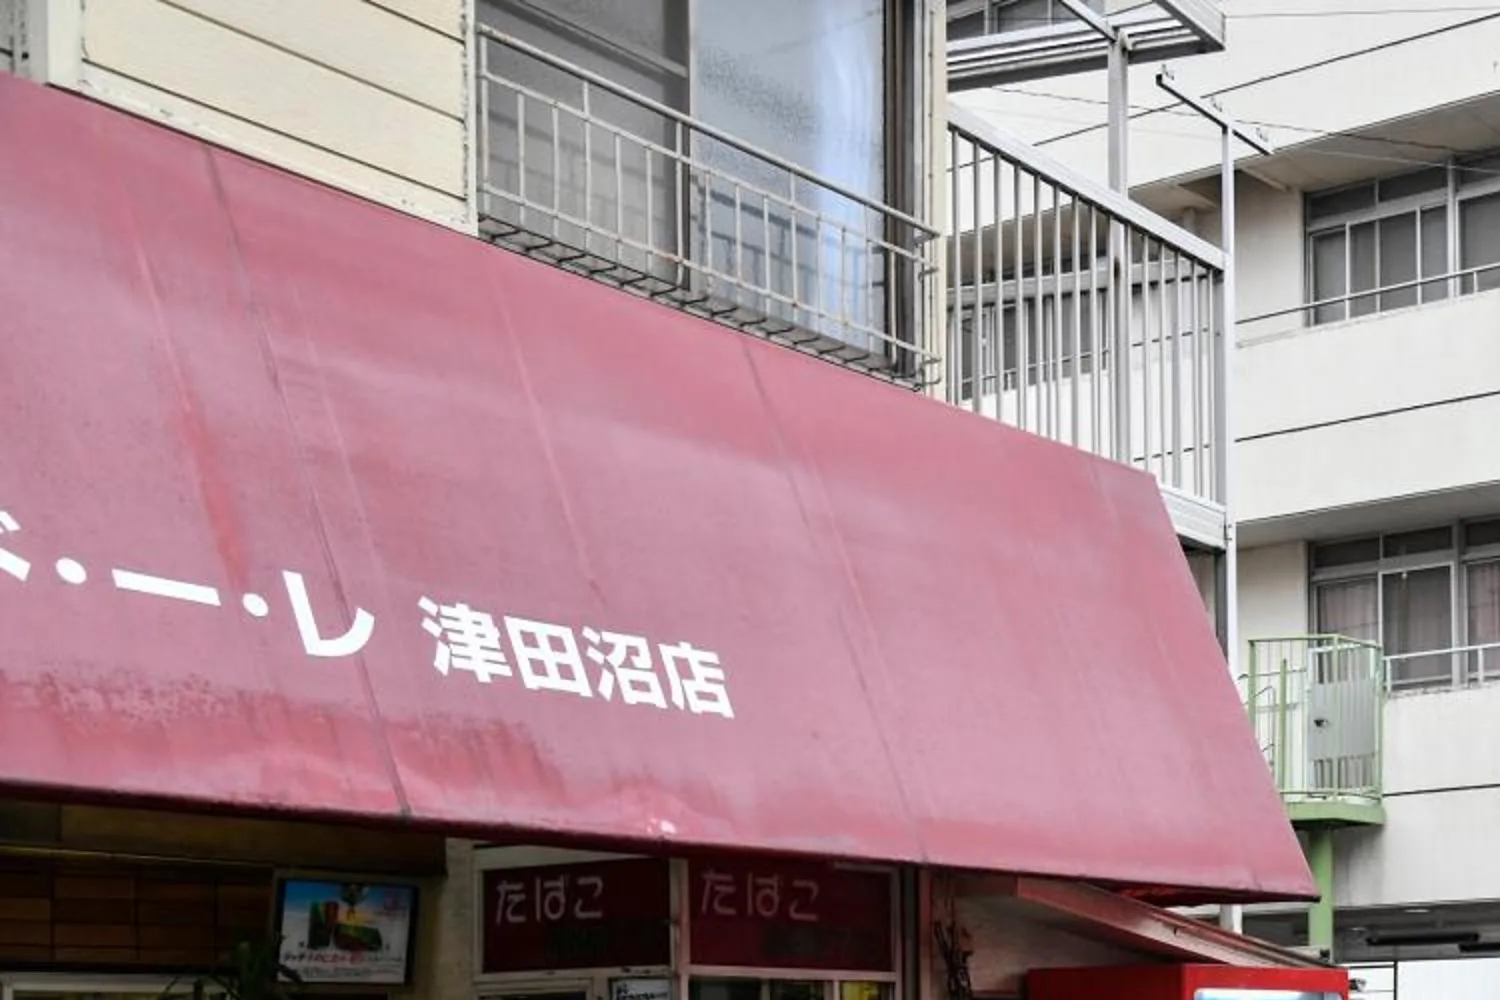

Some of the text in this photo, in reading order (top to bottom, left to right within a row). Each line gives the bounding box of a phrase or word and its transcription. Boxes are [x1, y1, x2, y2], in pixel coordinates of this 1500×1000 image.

[417, 595, 734, 718] 津田沼店
[496, 874, 604, 924] たばこ
[700, 869, 821, 922] たばこ
